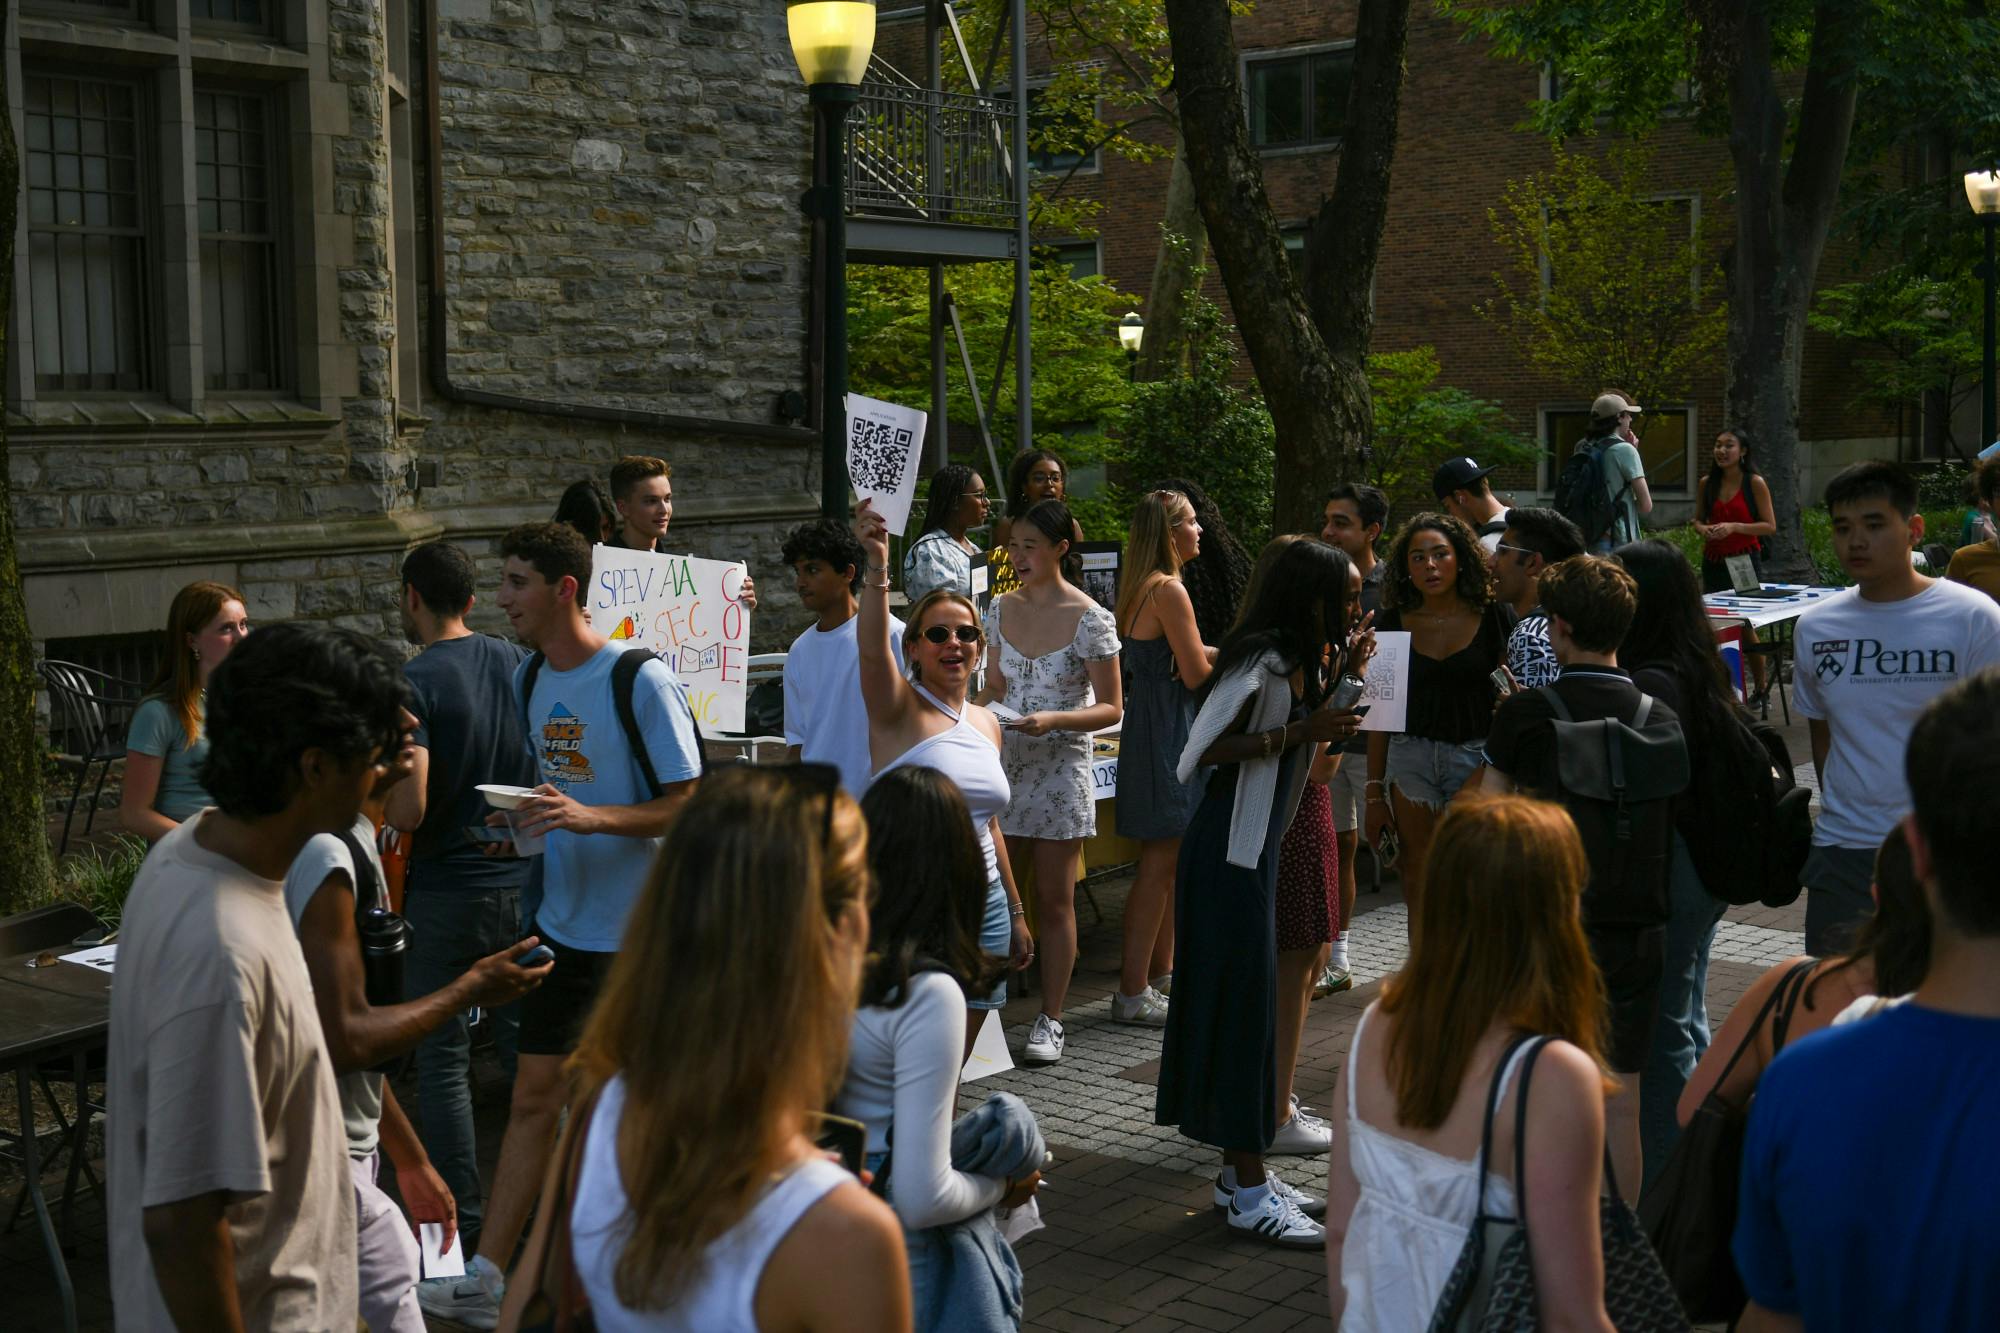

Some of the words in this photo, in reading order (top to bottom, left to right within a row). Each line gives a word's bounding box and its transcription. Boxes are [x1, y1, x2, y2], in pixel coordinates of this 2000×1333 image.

[598, 567, 654, 609] SPEV
[659, 558, 698, 598] AA
[654, 601, 708, 650] SEC
[1850, 638, 1956, 675] Penn
[543, 724, 586, 740] TRACK
[551, 740, 581, 751] FIELD
[1092, 765, 1118, 788] 128
